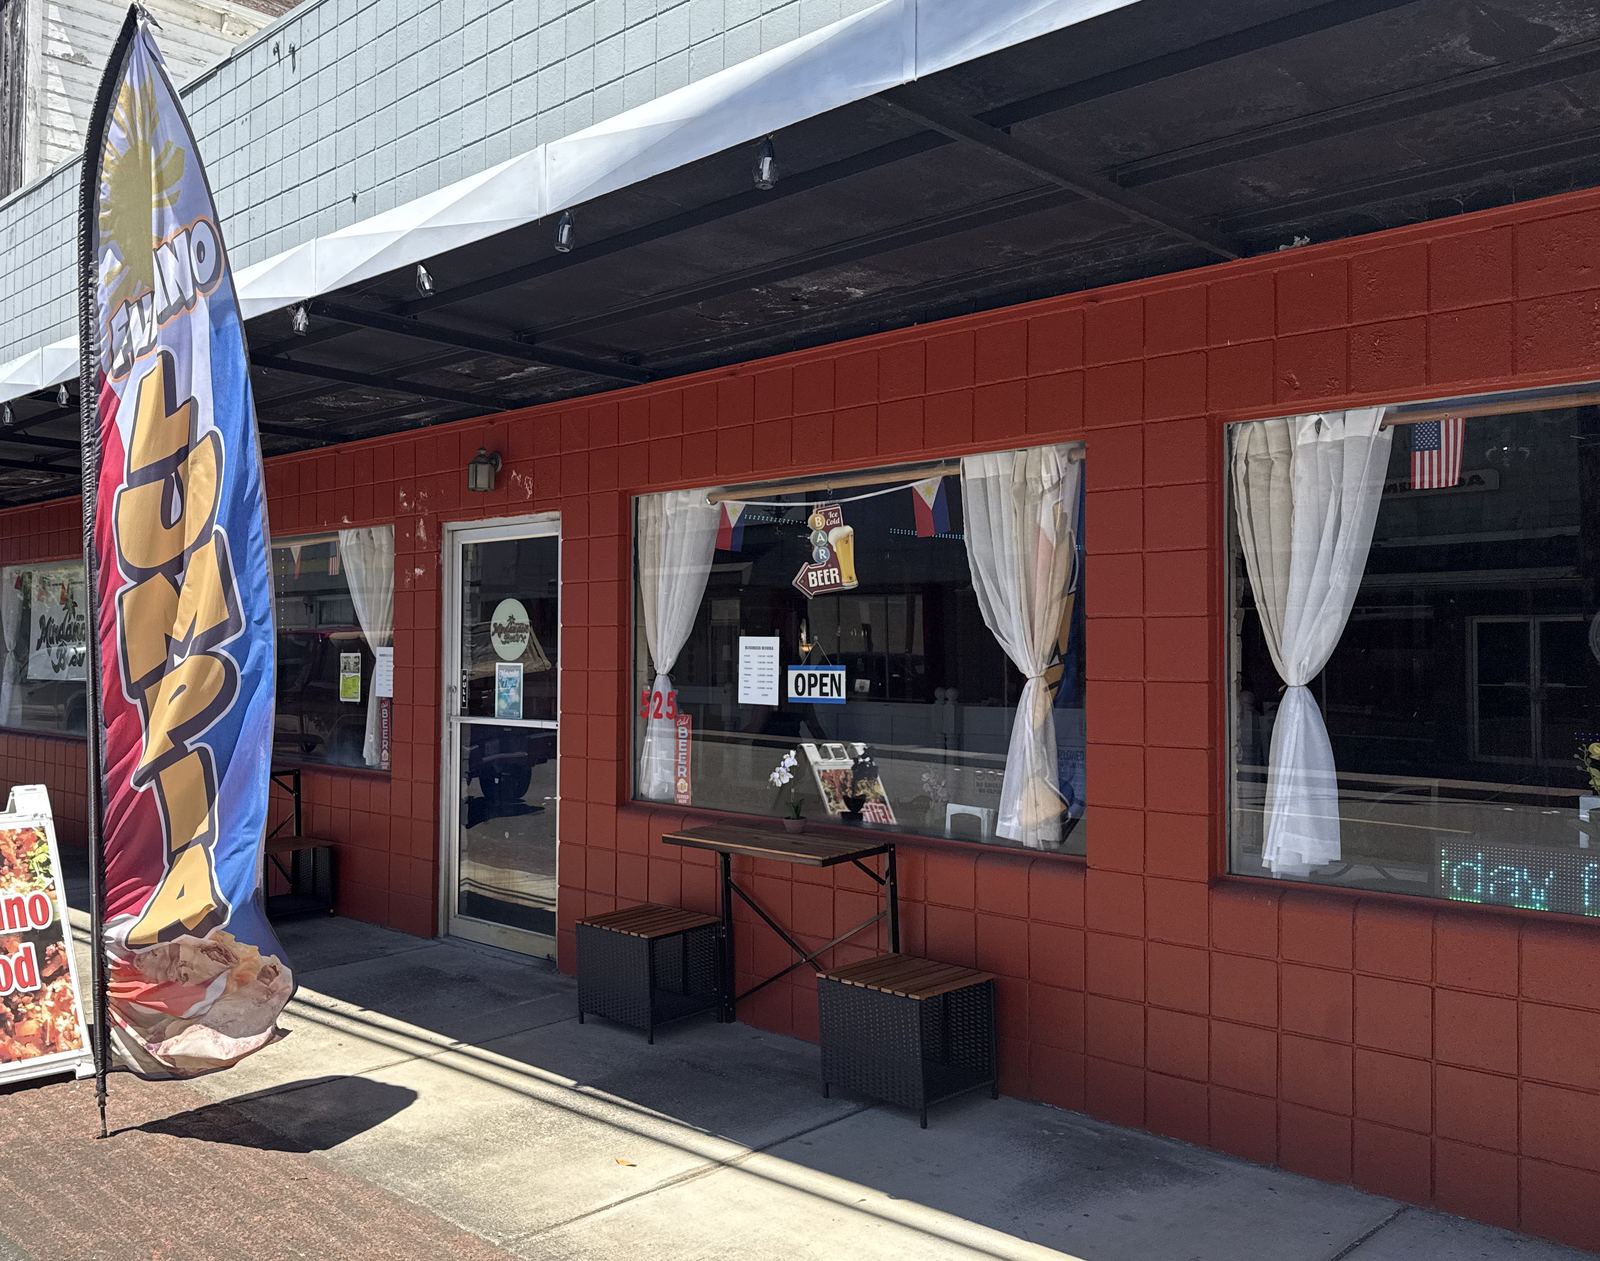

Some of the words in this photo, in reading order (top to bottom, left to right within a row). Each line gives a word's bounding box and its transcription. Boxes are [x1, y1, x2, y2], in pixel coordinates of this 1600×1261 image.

[825, 517, 840, 526] Cold
[828, 511, 838, 519] Ice
[815, 516, 827, 559] BAR
[807, 567, 840, 588] BEER
[114, 348, 244, 948] LUMPIA
[794, 673, 842, 697] OPEN
[640, 690, 676, 719] 525
[380, 708, 389, 749] BEER
[677, 726, 688, 778] BEER
